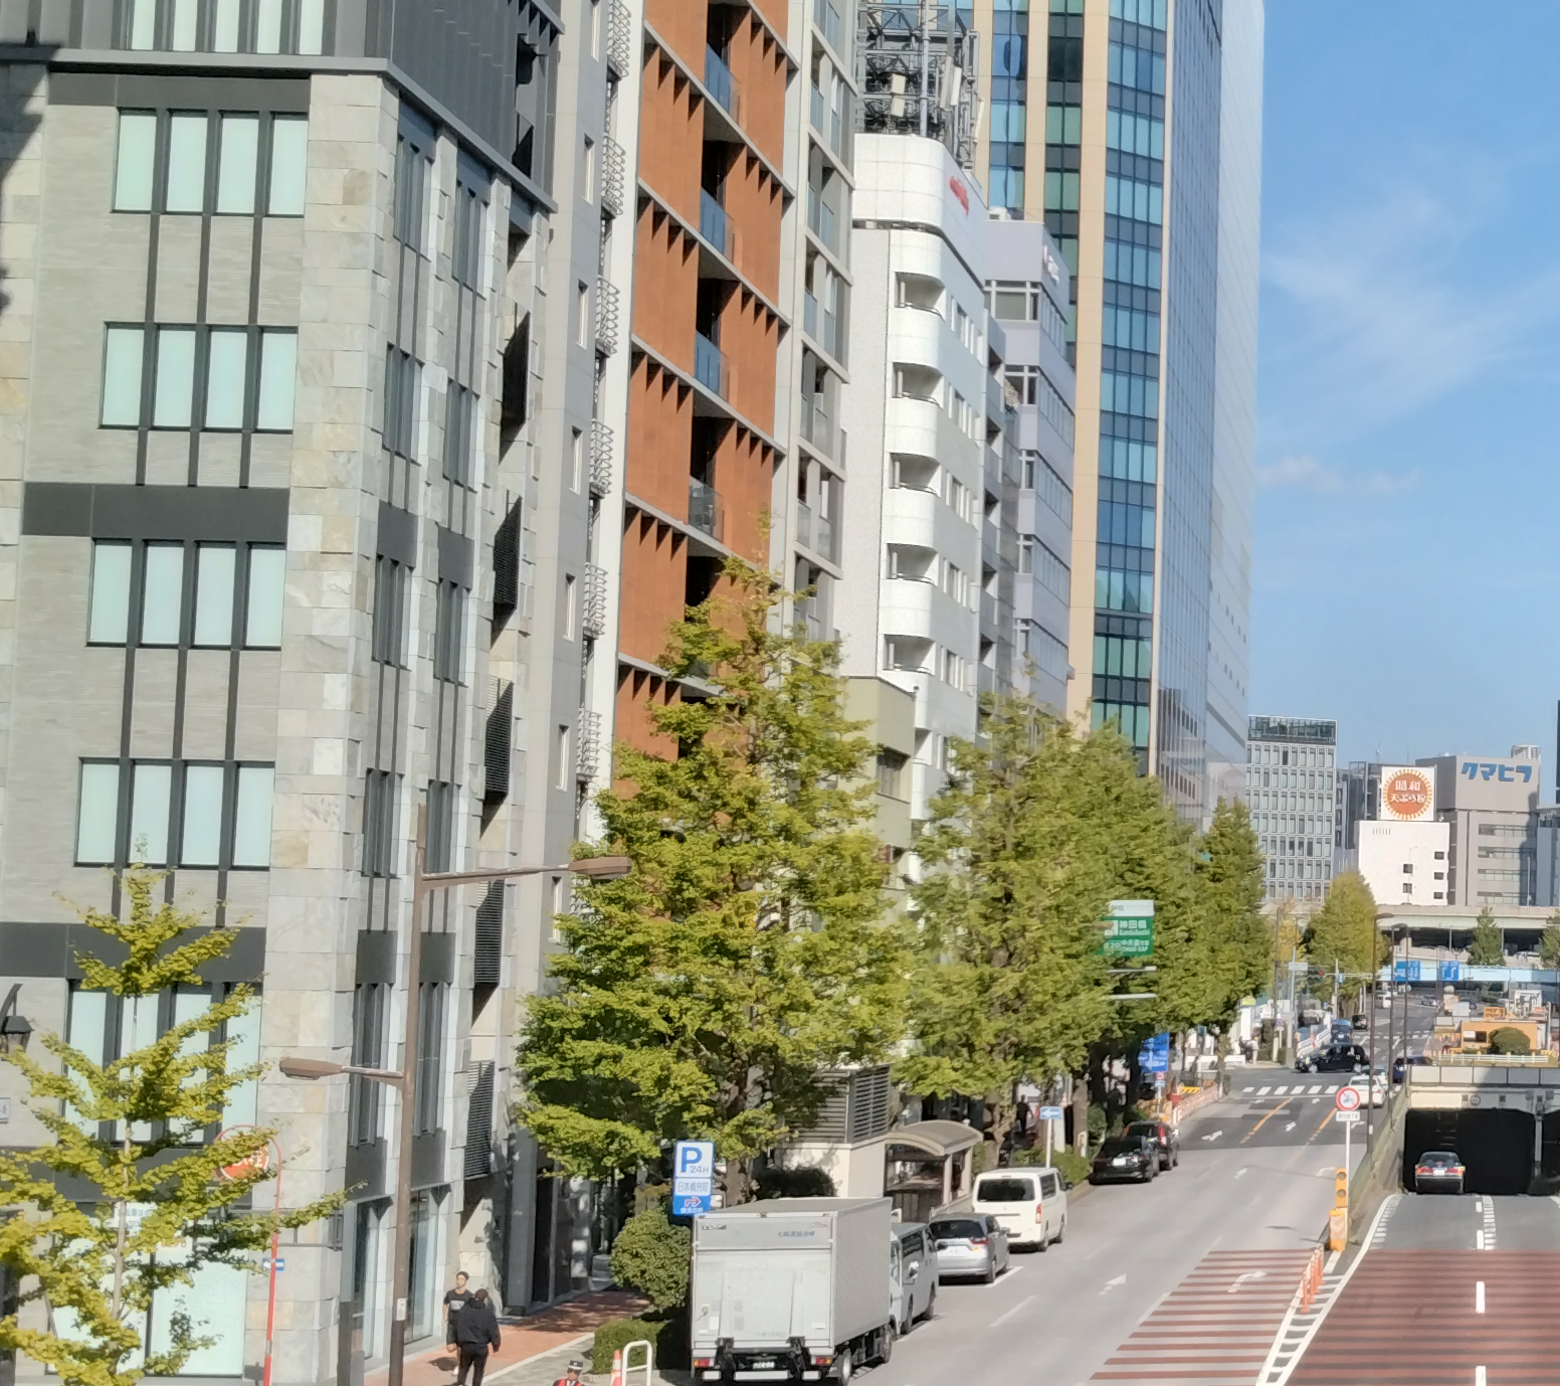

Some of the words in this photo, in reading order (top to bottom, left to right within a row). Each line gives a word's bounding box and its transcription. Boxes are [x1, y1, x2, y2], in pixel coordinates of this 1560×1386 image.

[1461, 762, 1532, 783] クマヒラ
[1395, 779, 1421, 792] 昭和
[680, 1146, 703, 1173] P
[689, 1165, 709, 1174] 24H
